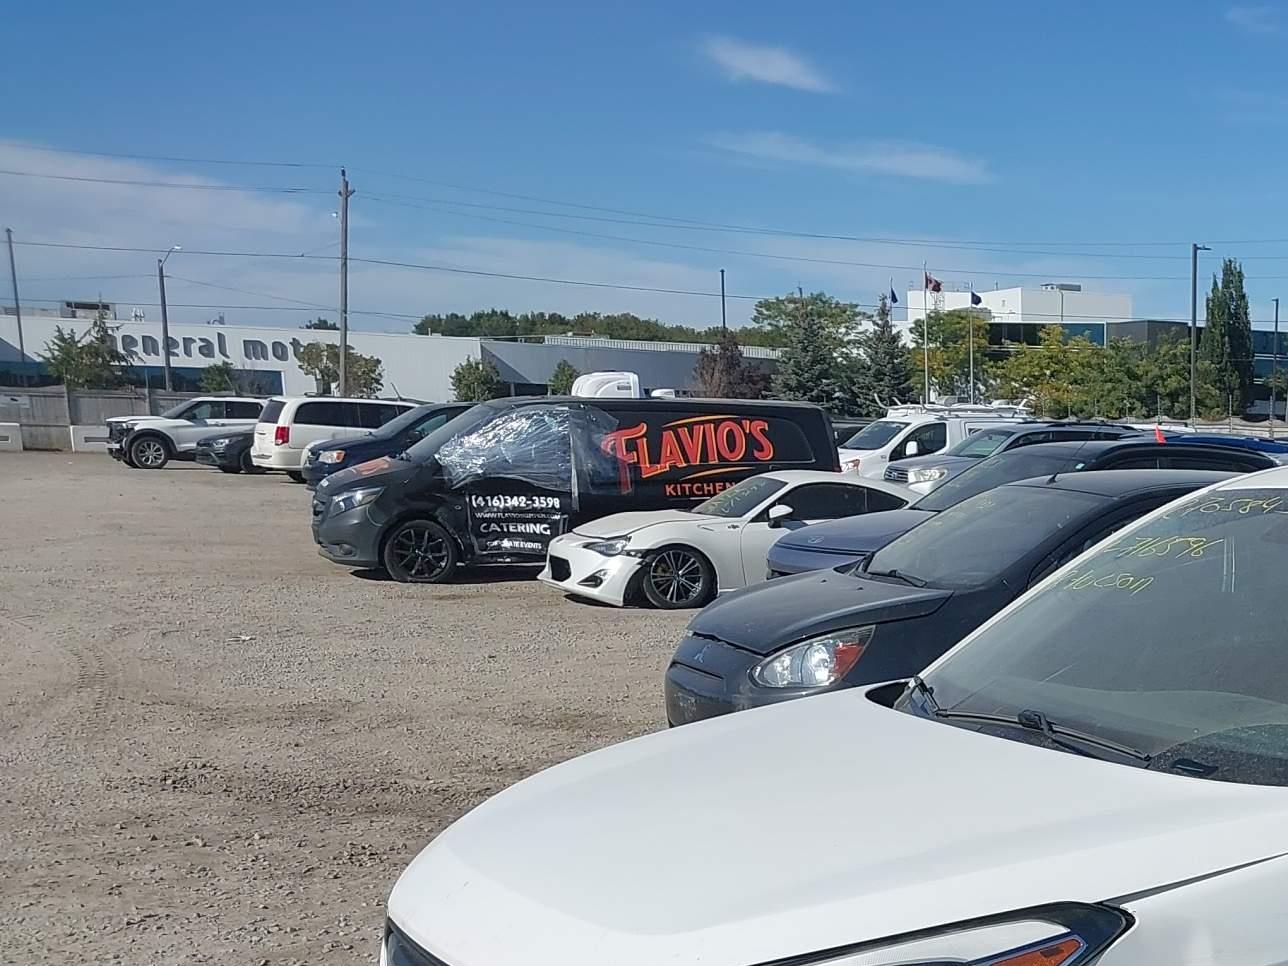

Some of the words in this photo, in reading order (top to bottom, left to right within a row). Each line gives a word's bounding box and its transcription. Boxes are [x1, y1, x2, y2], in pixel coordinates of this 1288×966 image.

[600, 420, 775, 495] FLAVIO'S
[471, 494, 560, 508] (416)342-3598
[480, 522, 551, 535] CATERING
